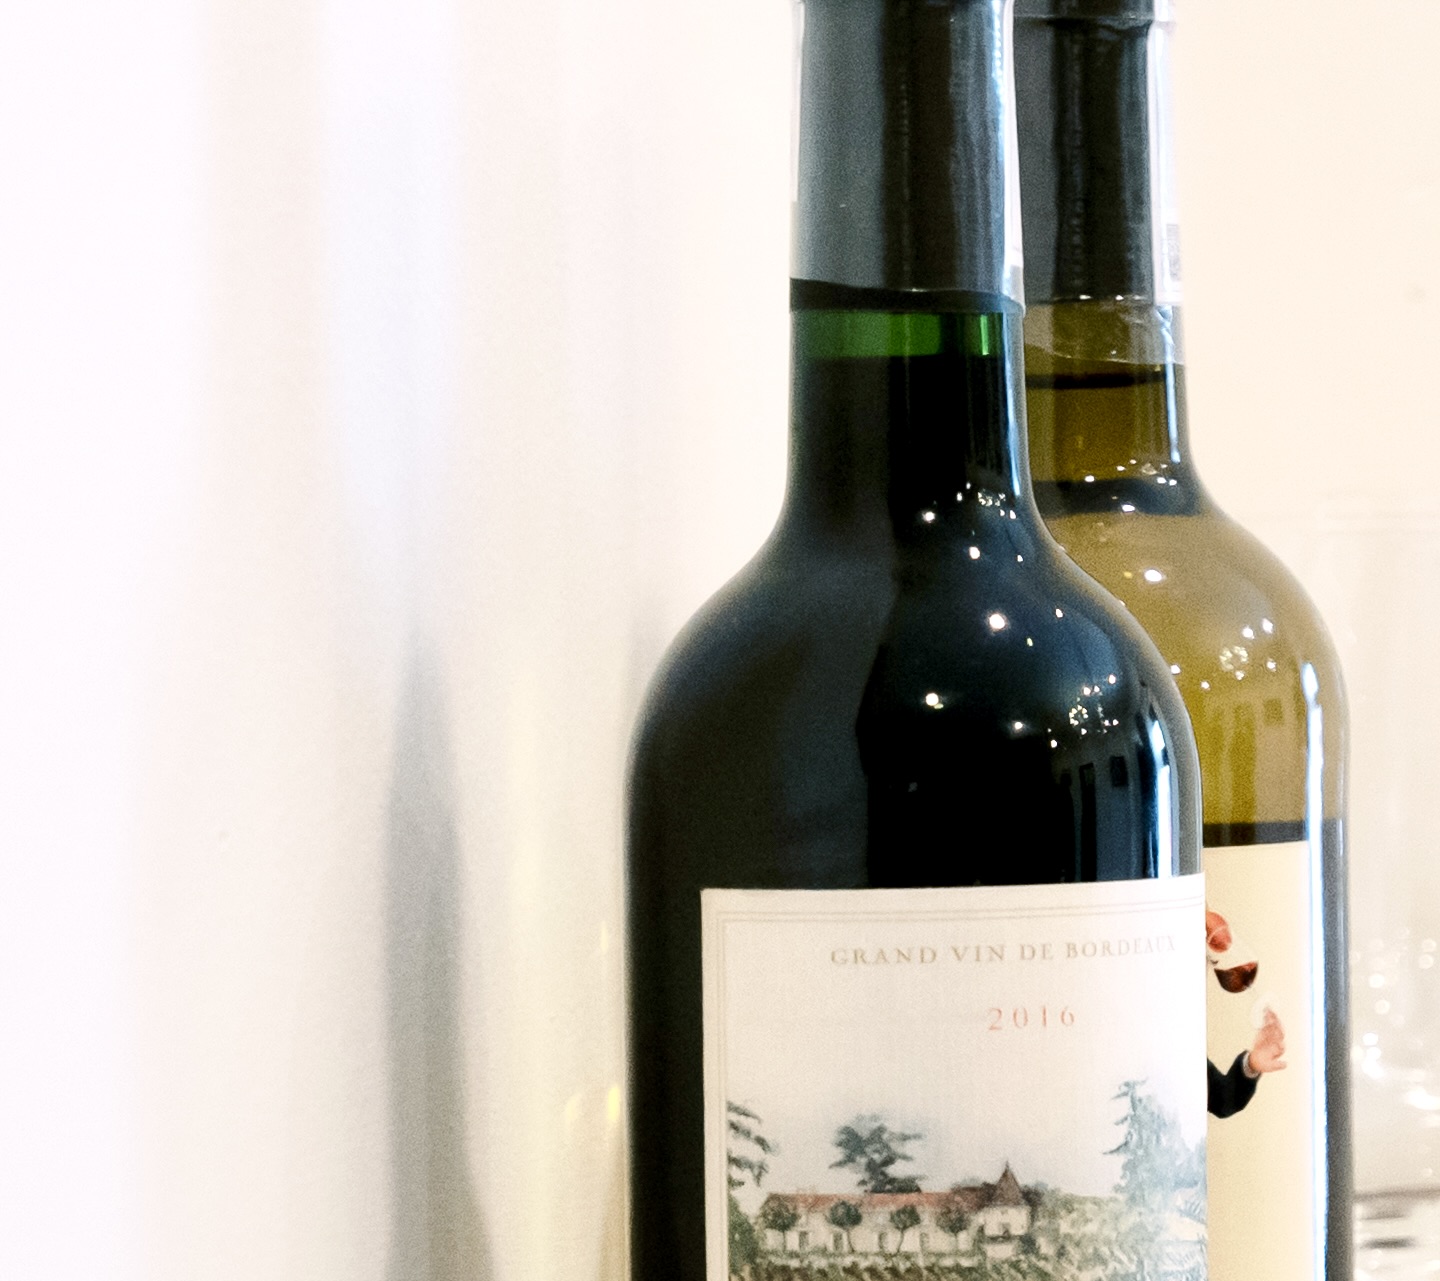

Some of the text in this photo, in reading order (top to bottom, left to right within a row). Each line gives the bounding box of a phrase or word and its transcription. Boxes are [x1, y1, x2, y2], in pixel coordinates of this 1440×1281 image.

[830, 935, 1177, 965] GRAND VIN DE BORDEAUX
[987, 1005, 1076, 1031] 2016
